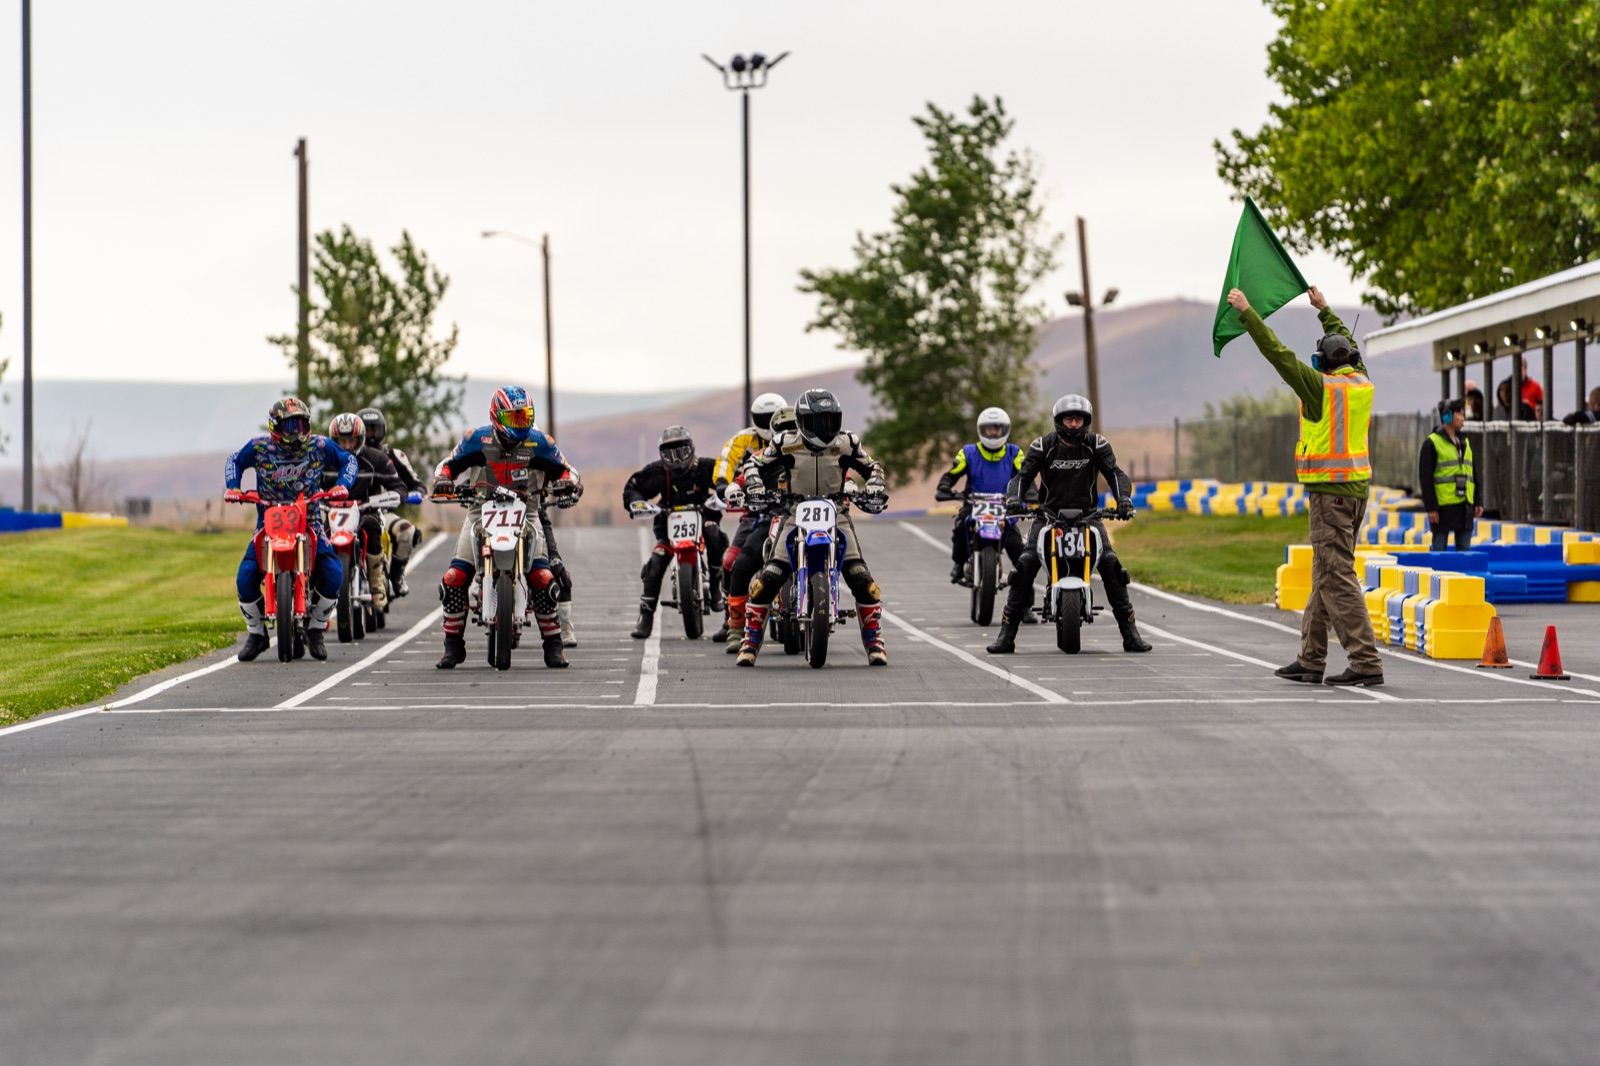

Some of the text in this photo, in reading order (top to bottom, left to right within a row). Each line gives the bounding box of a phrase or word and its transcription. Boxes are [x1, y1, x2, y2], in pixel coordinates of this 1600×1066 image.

[1050, 459, 1090, 469] RST
[271, 510, 298, 533] 33
[337, 512, 350, 527] 7
[484, 510, 523, 528] 711
[802, 507, 829, 522] 281
[673, 523, 696, 538] 253
[1056, 532, 1085, 557] 134
